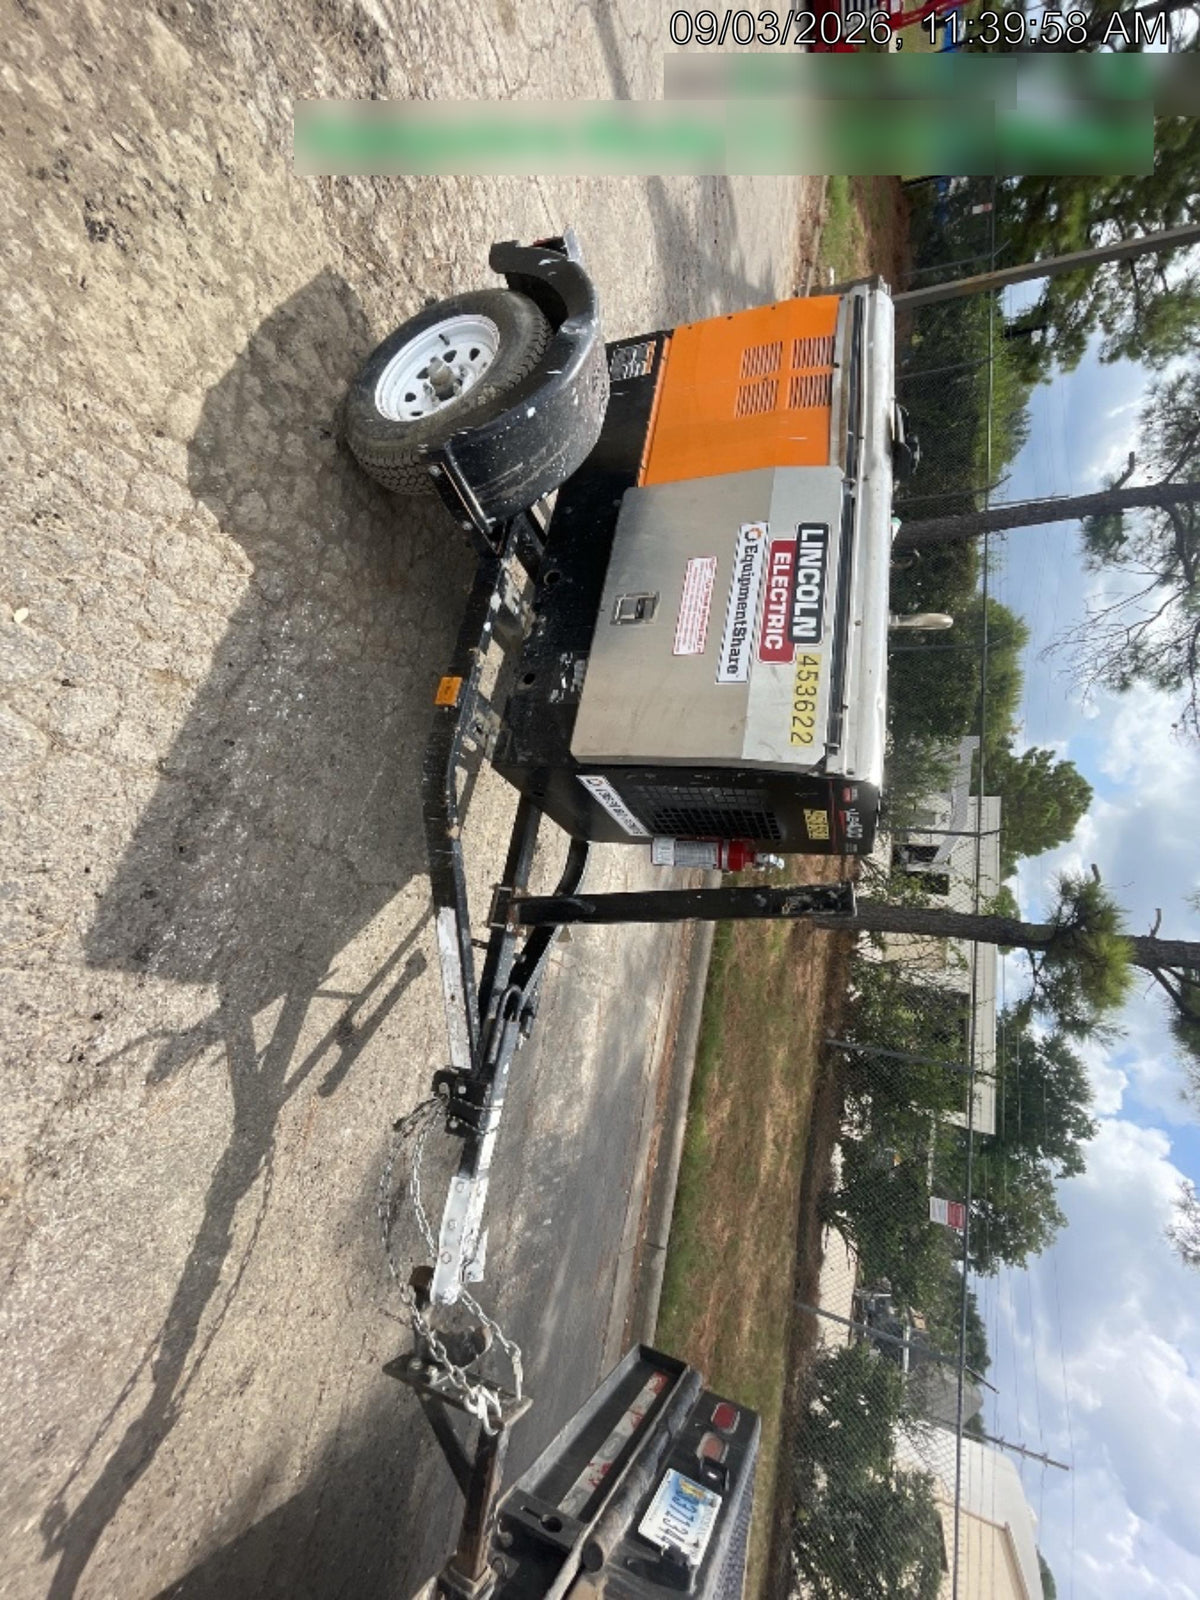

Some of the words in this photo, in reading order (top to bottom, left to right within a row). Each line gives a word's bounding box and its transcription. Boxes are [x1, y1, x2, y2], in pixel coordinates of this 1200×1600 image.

[726, 544, 758, 675] EquipmentShare
[764, 551, 792, 650] ELECTRIC
[792, 528, 824, 638] LINCOLN
[790, 655, 819, 745] 453622
